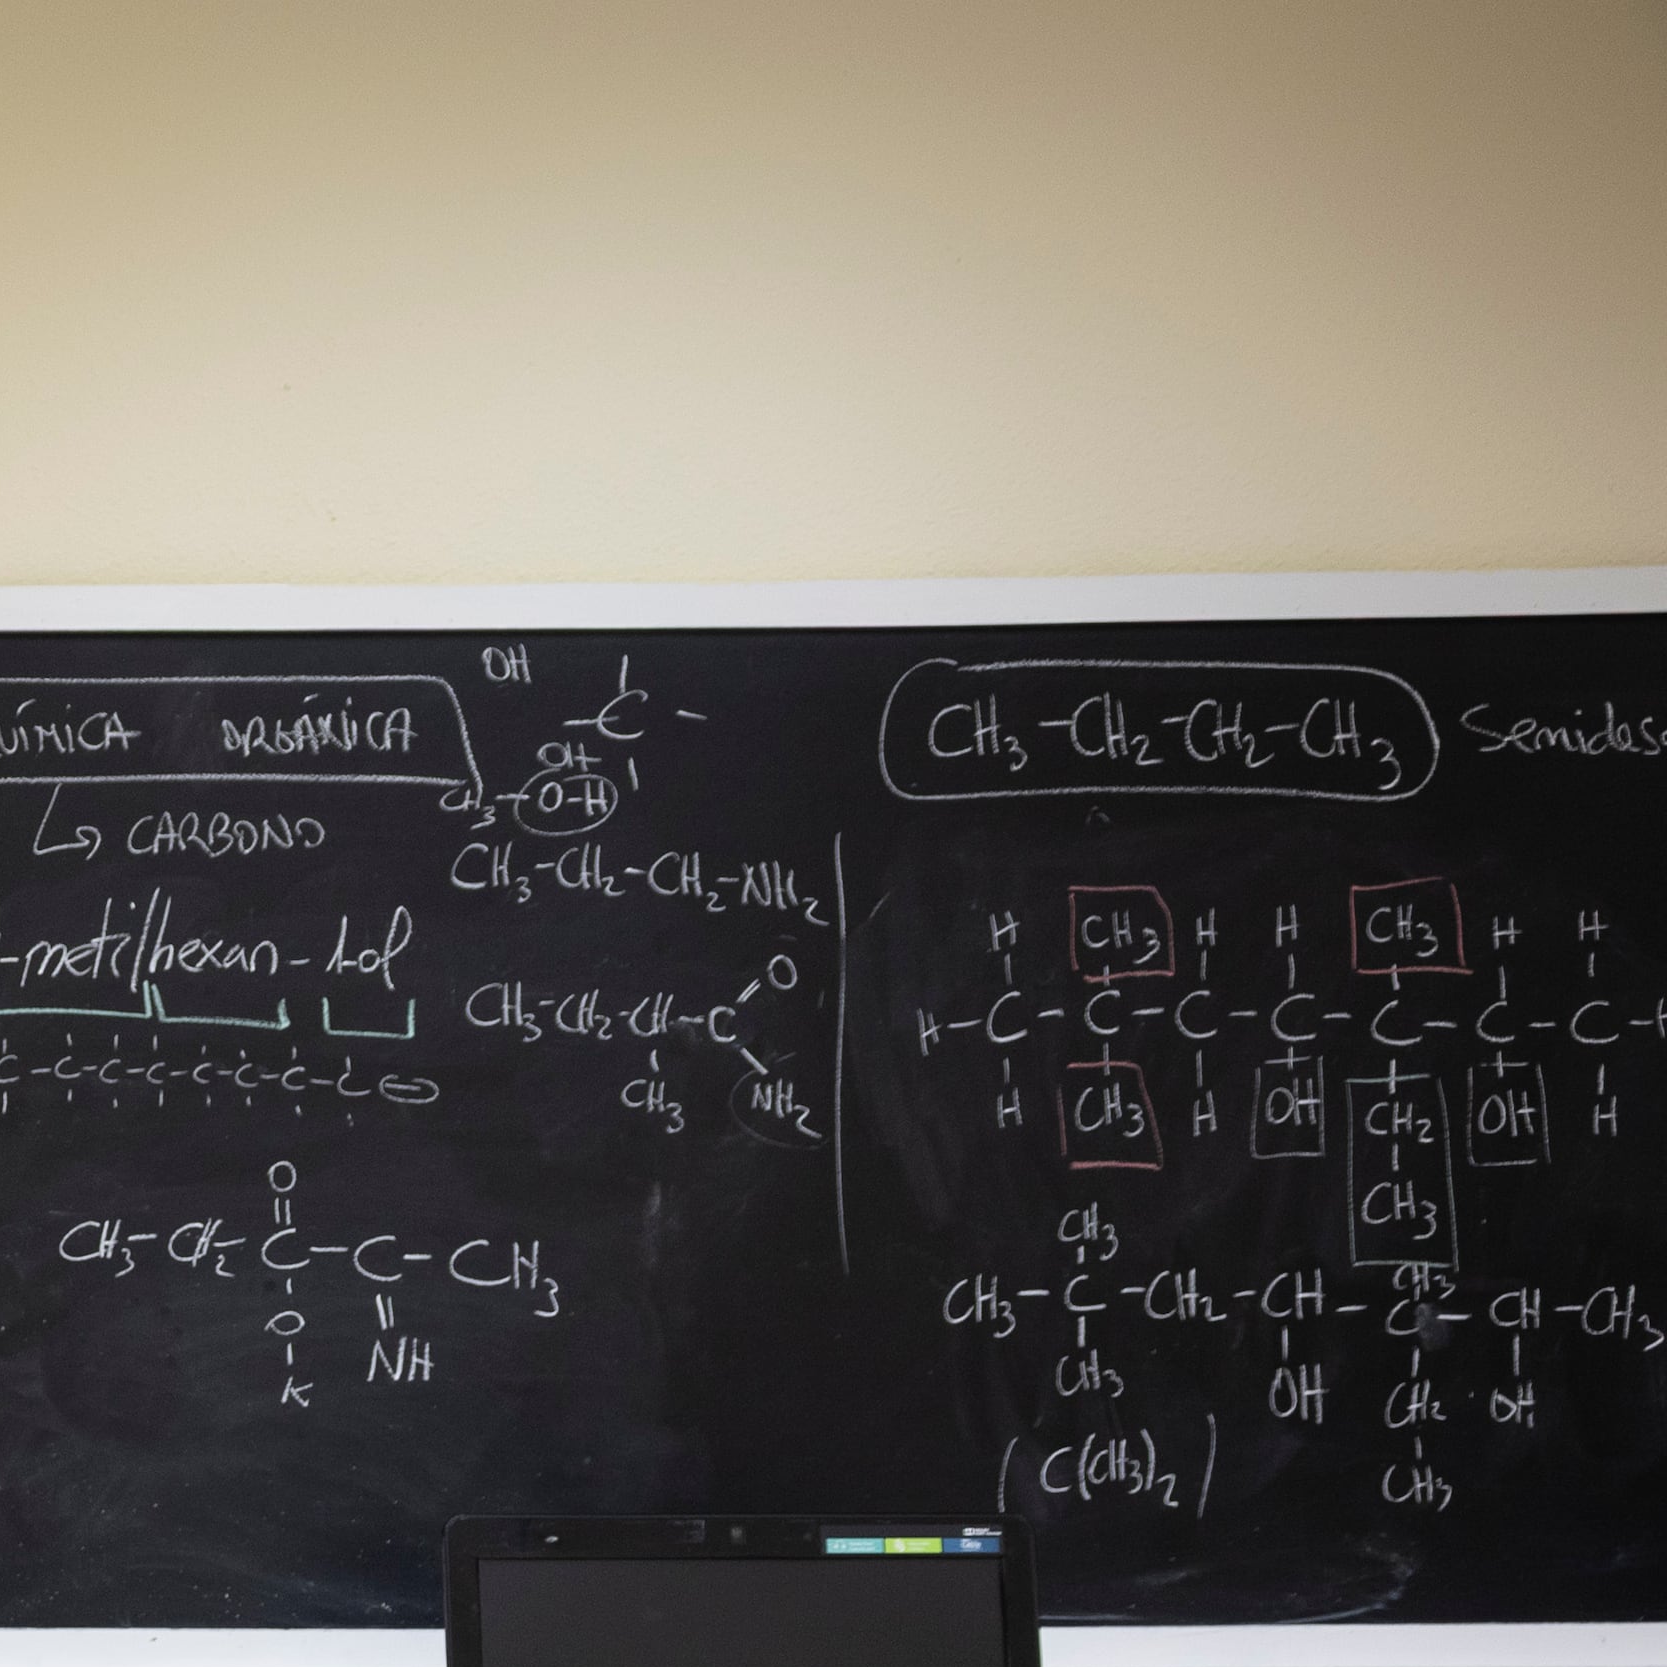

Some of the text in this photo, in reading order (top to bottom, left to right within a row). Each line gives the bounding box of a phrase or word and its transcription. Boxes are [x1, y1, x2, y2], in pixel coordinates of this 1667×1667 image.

[481, 643, 532, 683] OH
[128, 812, 325, 857] CARBONO
[368, 1336, 435, 1382] NH
[1269, 1363, 1329, 1424] OH
